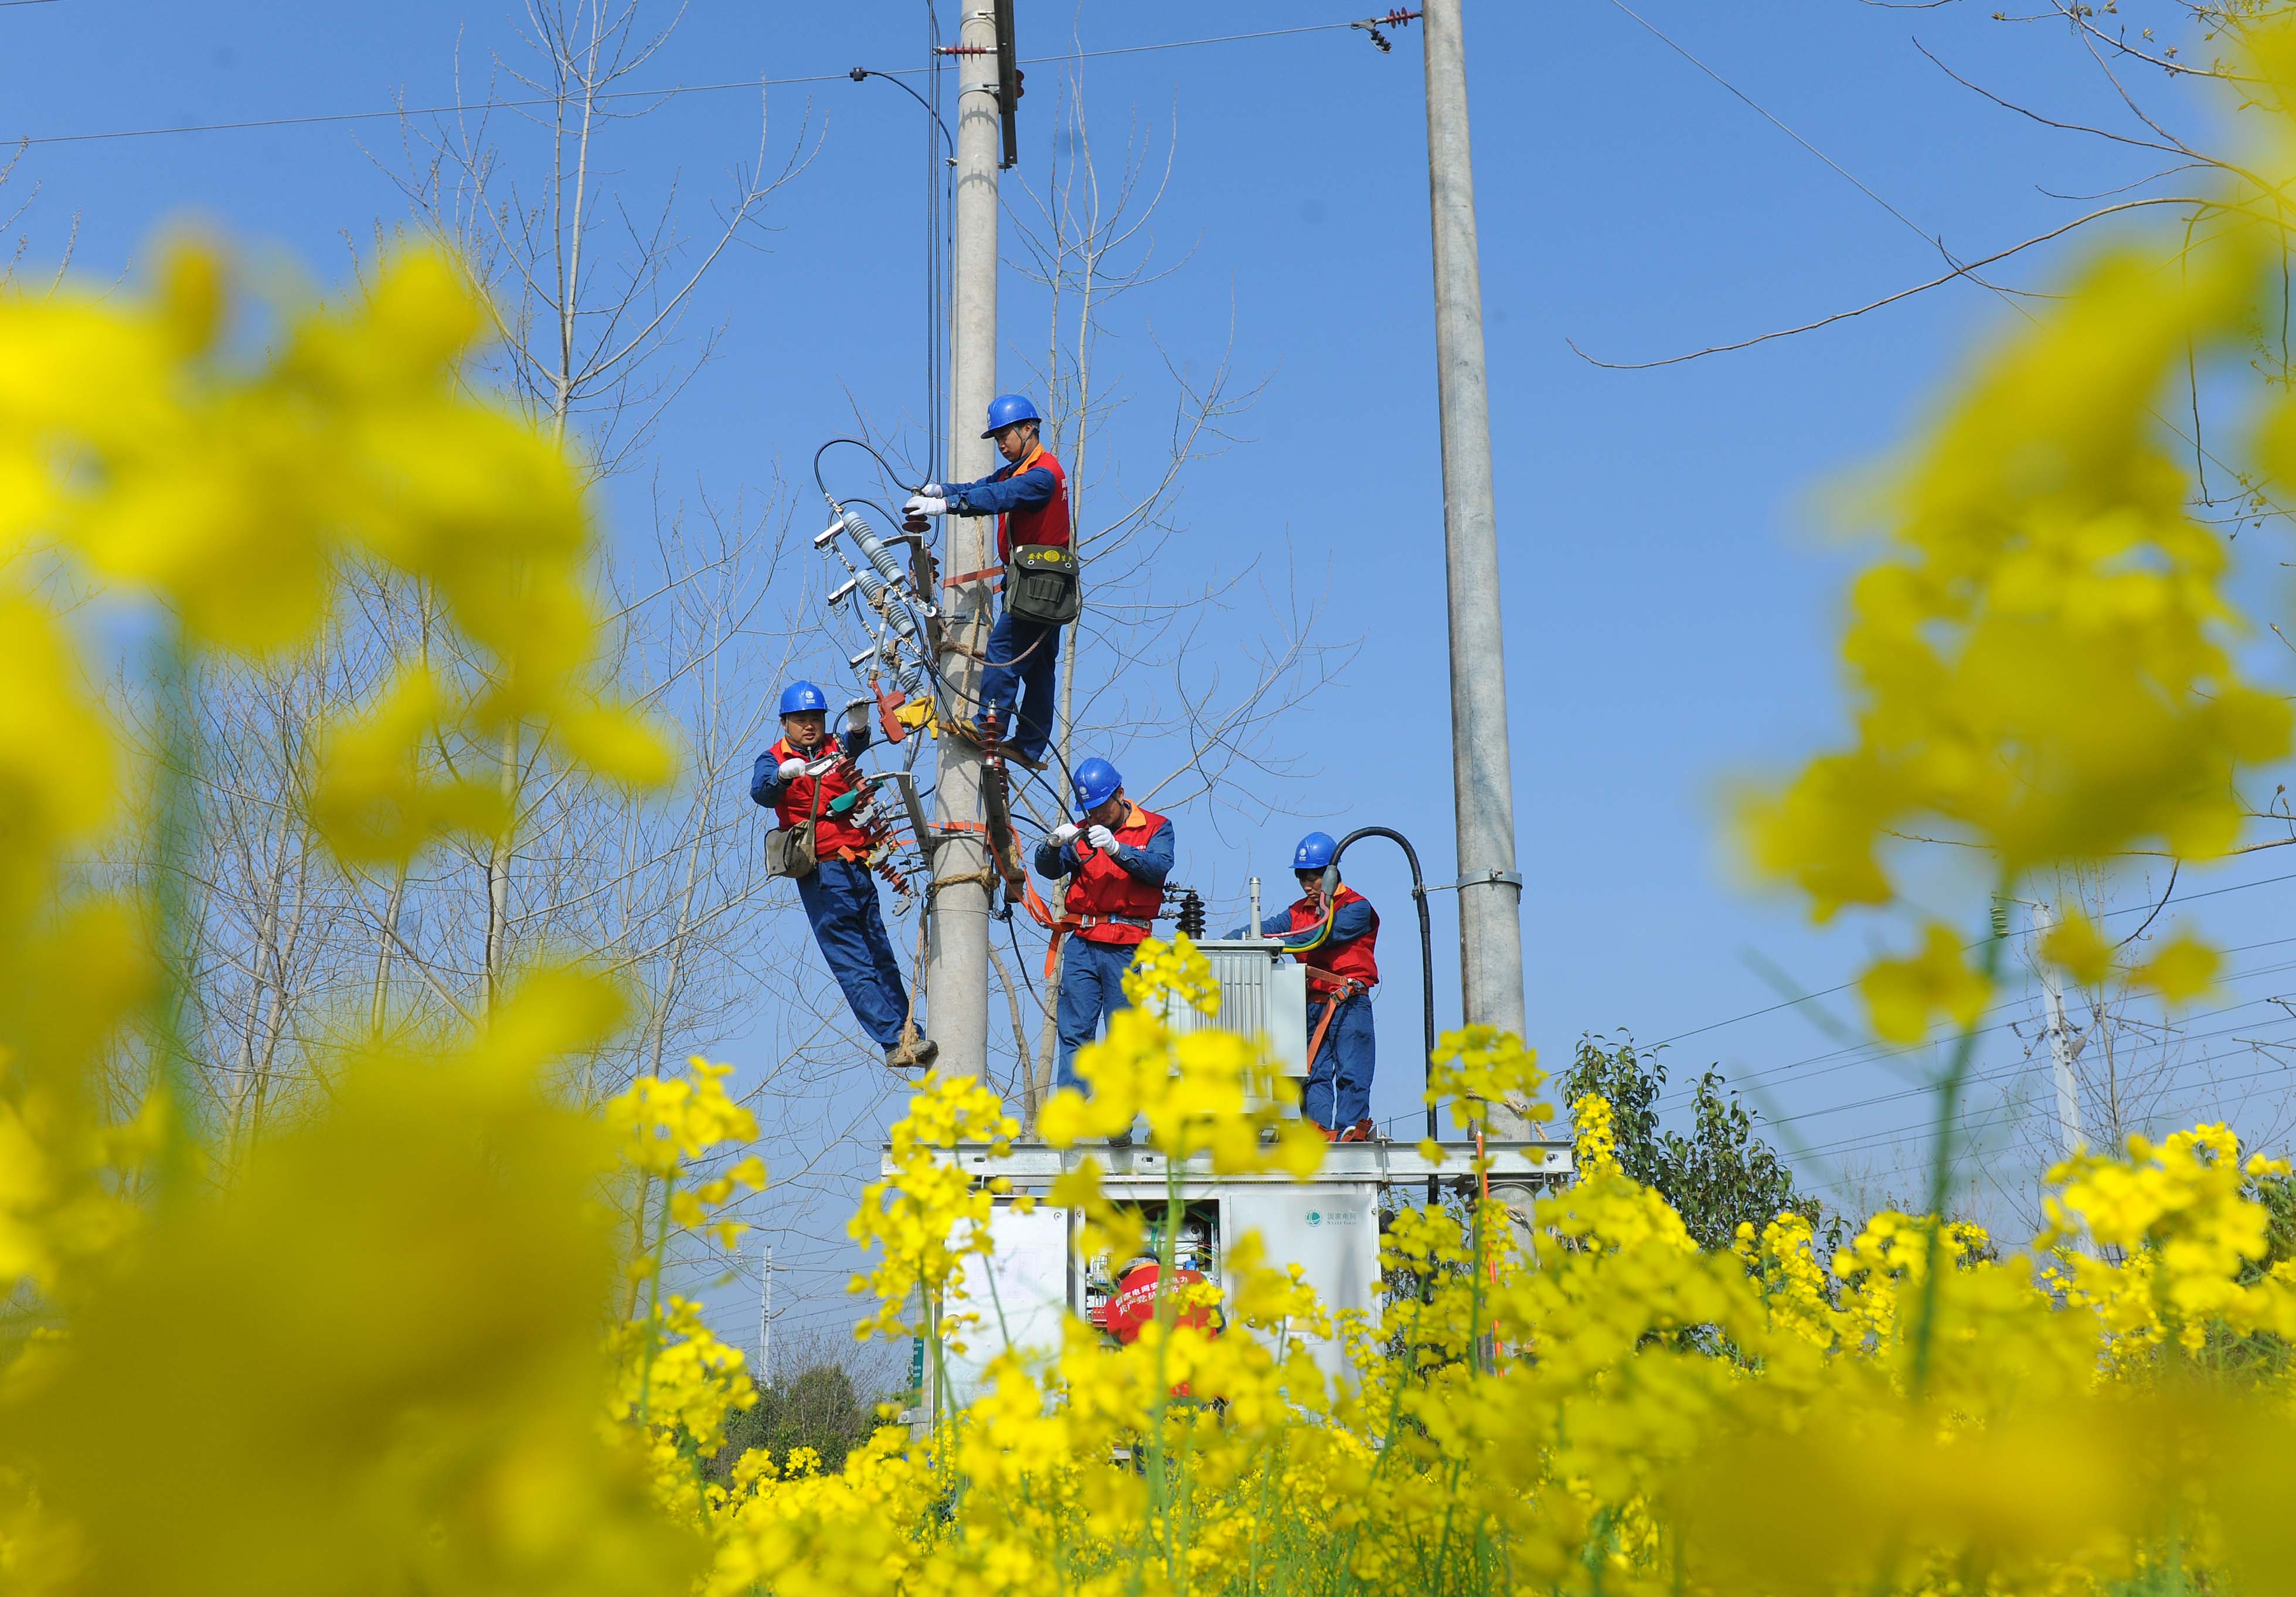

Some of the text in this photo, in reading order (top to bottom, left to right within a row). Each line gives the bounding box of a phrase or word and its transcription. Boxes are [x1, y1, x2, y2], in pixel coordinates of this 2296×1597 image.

[1115, 1276, 1188, 1308] 国家电网安电力
